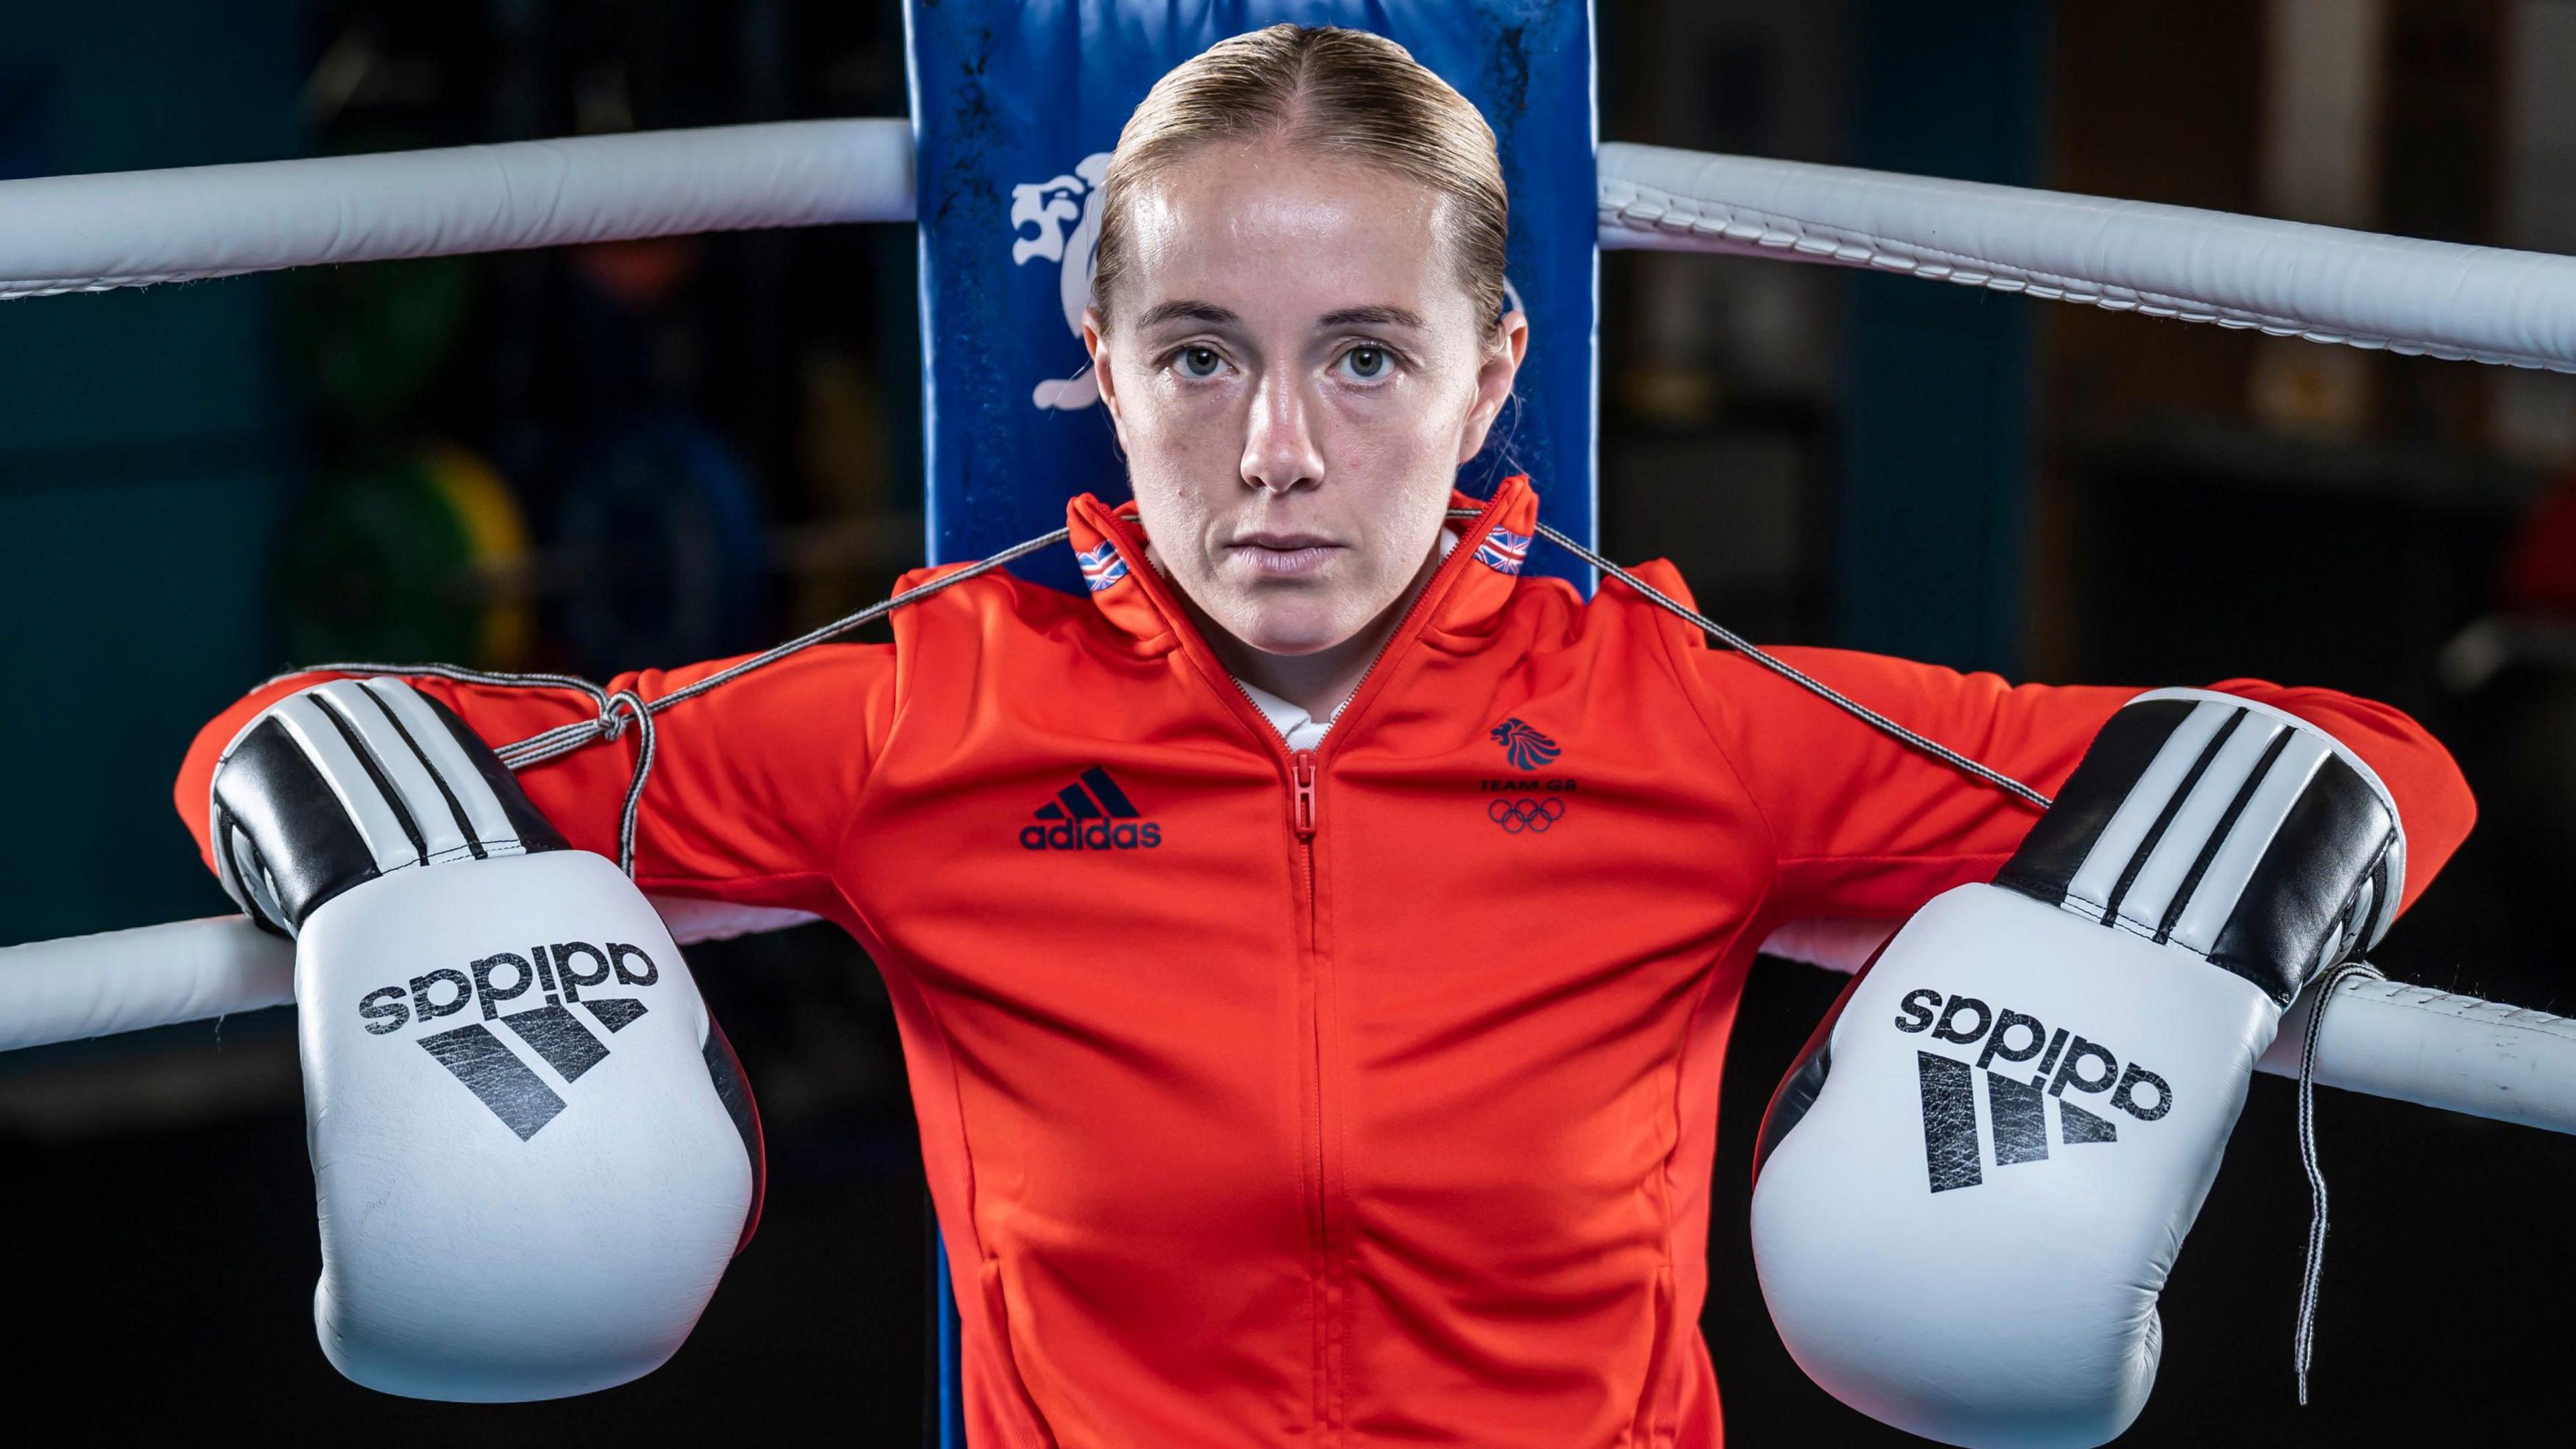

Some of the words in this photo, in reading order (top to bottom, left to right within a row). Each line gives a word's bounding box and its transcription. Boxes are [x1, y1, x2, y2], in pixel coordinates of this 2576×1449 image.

[1479, 779, 1539, 792] TEAM
[1545, 779, 1578, 791] GB
[1020, 816, 1162, 850] adidas
[358, 941, 659, 1035] adidas
[1894, 988, 2173, 1121] adidas
